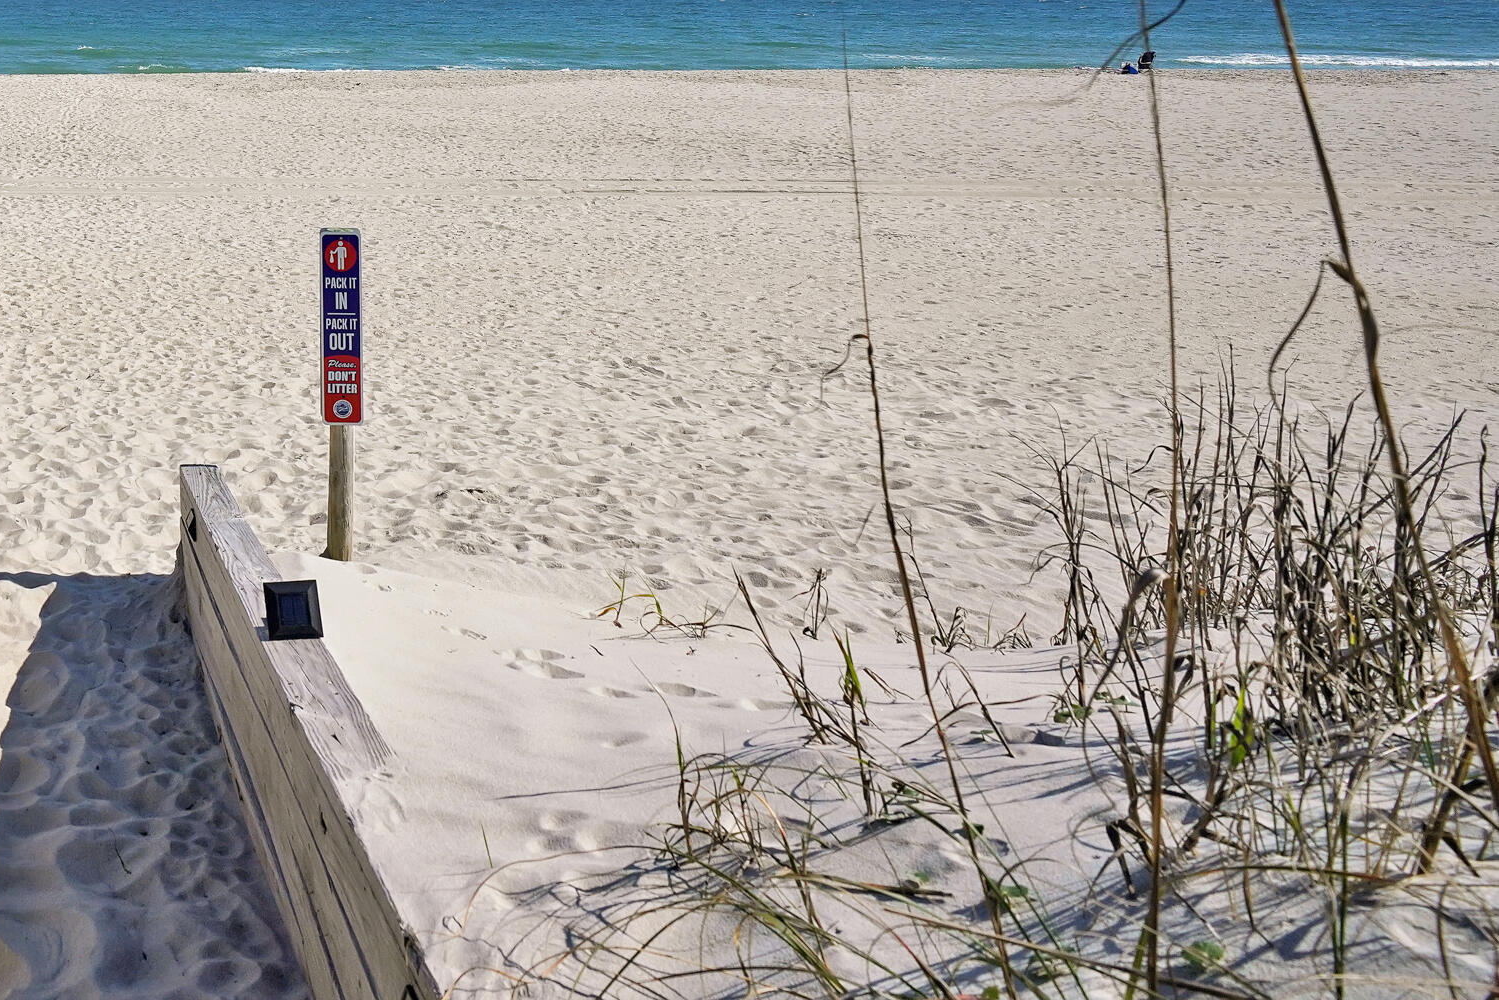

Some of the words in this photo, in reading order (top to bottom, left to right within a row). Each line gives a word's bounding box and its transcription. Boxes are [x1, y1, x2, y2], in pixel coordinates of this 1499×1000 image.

[325, 277, 347, 289] PACK
[349, 277, 357, 289] IT
[335, 291, 348, 310] IN
[325, 318, 348, 330] PACK
[350, 318, 358, 330] IT
[329, 332, 355, 351] OUT
[328, 370, 357, 381] DON'T
[327, 383, 358, 394] LITTER
